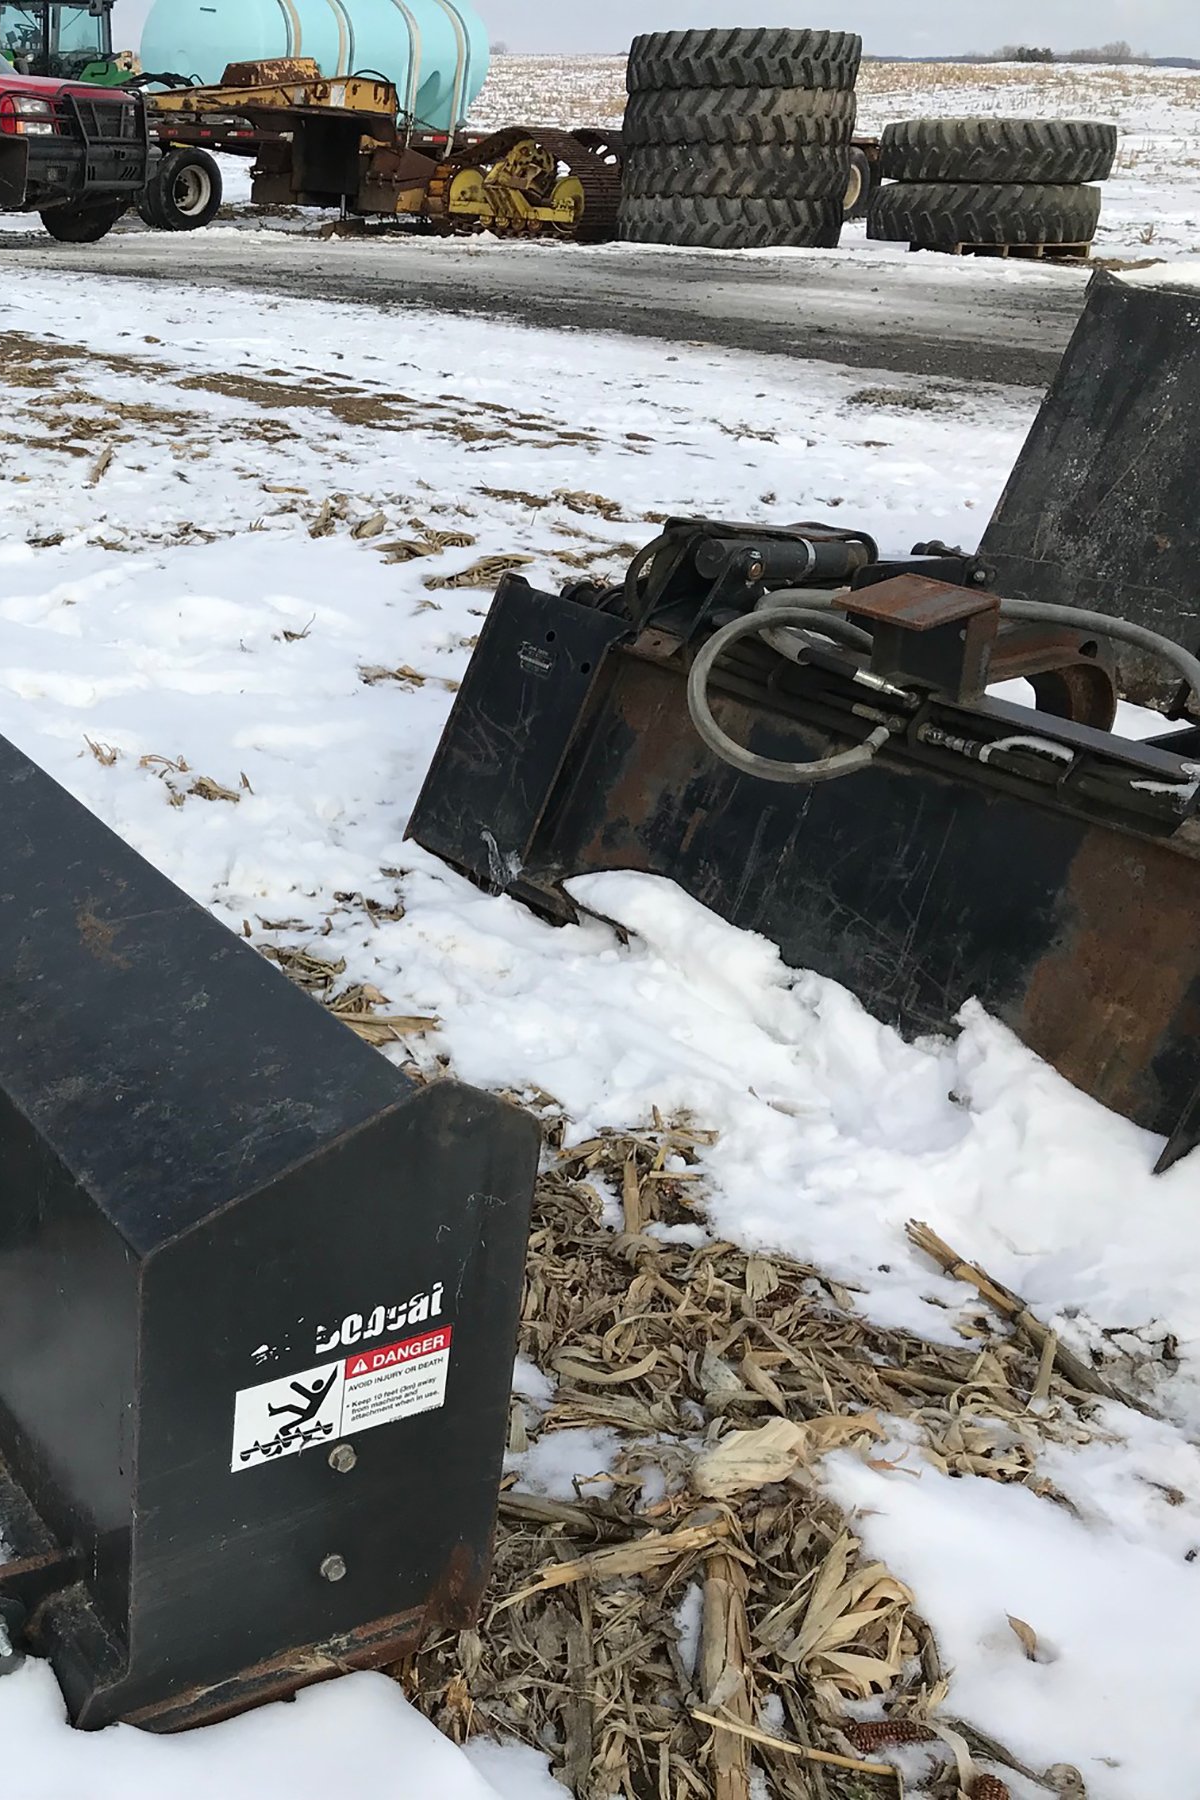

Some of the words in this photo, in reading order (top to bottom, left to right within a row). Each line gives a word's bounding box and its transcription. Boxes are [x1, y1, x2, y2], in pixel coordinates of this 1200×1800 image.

[372, 1334, 445, 1368] DANGER
[348, 1379, 373, 1392] AVOID
[374, 1369, 403, 1384] INJURY
[404, 1366, 417, 1375] OR
[418, 1356, 444, 1371] DEATH
[350, 1403, 394, 1422] attachment
[394, 1397, 416, 1408] when
[416, 1393, 424, 1401] in
[424, 1389, 440, 1398] use.
[351, 1397, 372, 1408] Keep
[373, 1392, 383, 1401] 10
[383, 1387, 398, 1398] feet
[417, 1376, 437, 1388] away
[351, 1404, 370, 1415] from
[370, 1394, 403, 1409] machine
[404, 1389, 419, 1398] and
